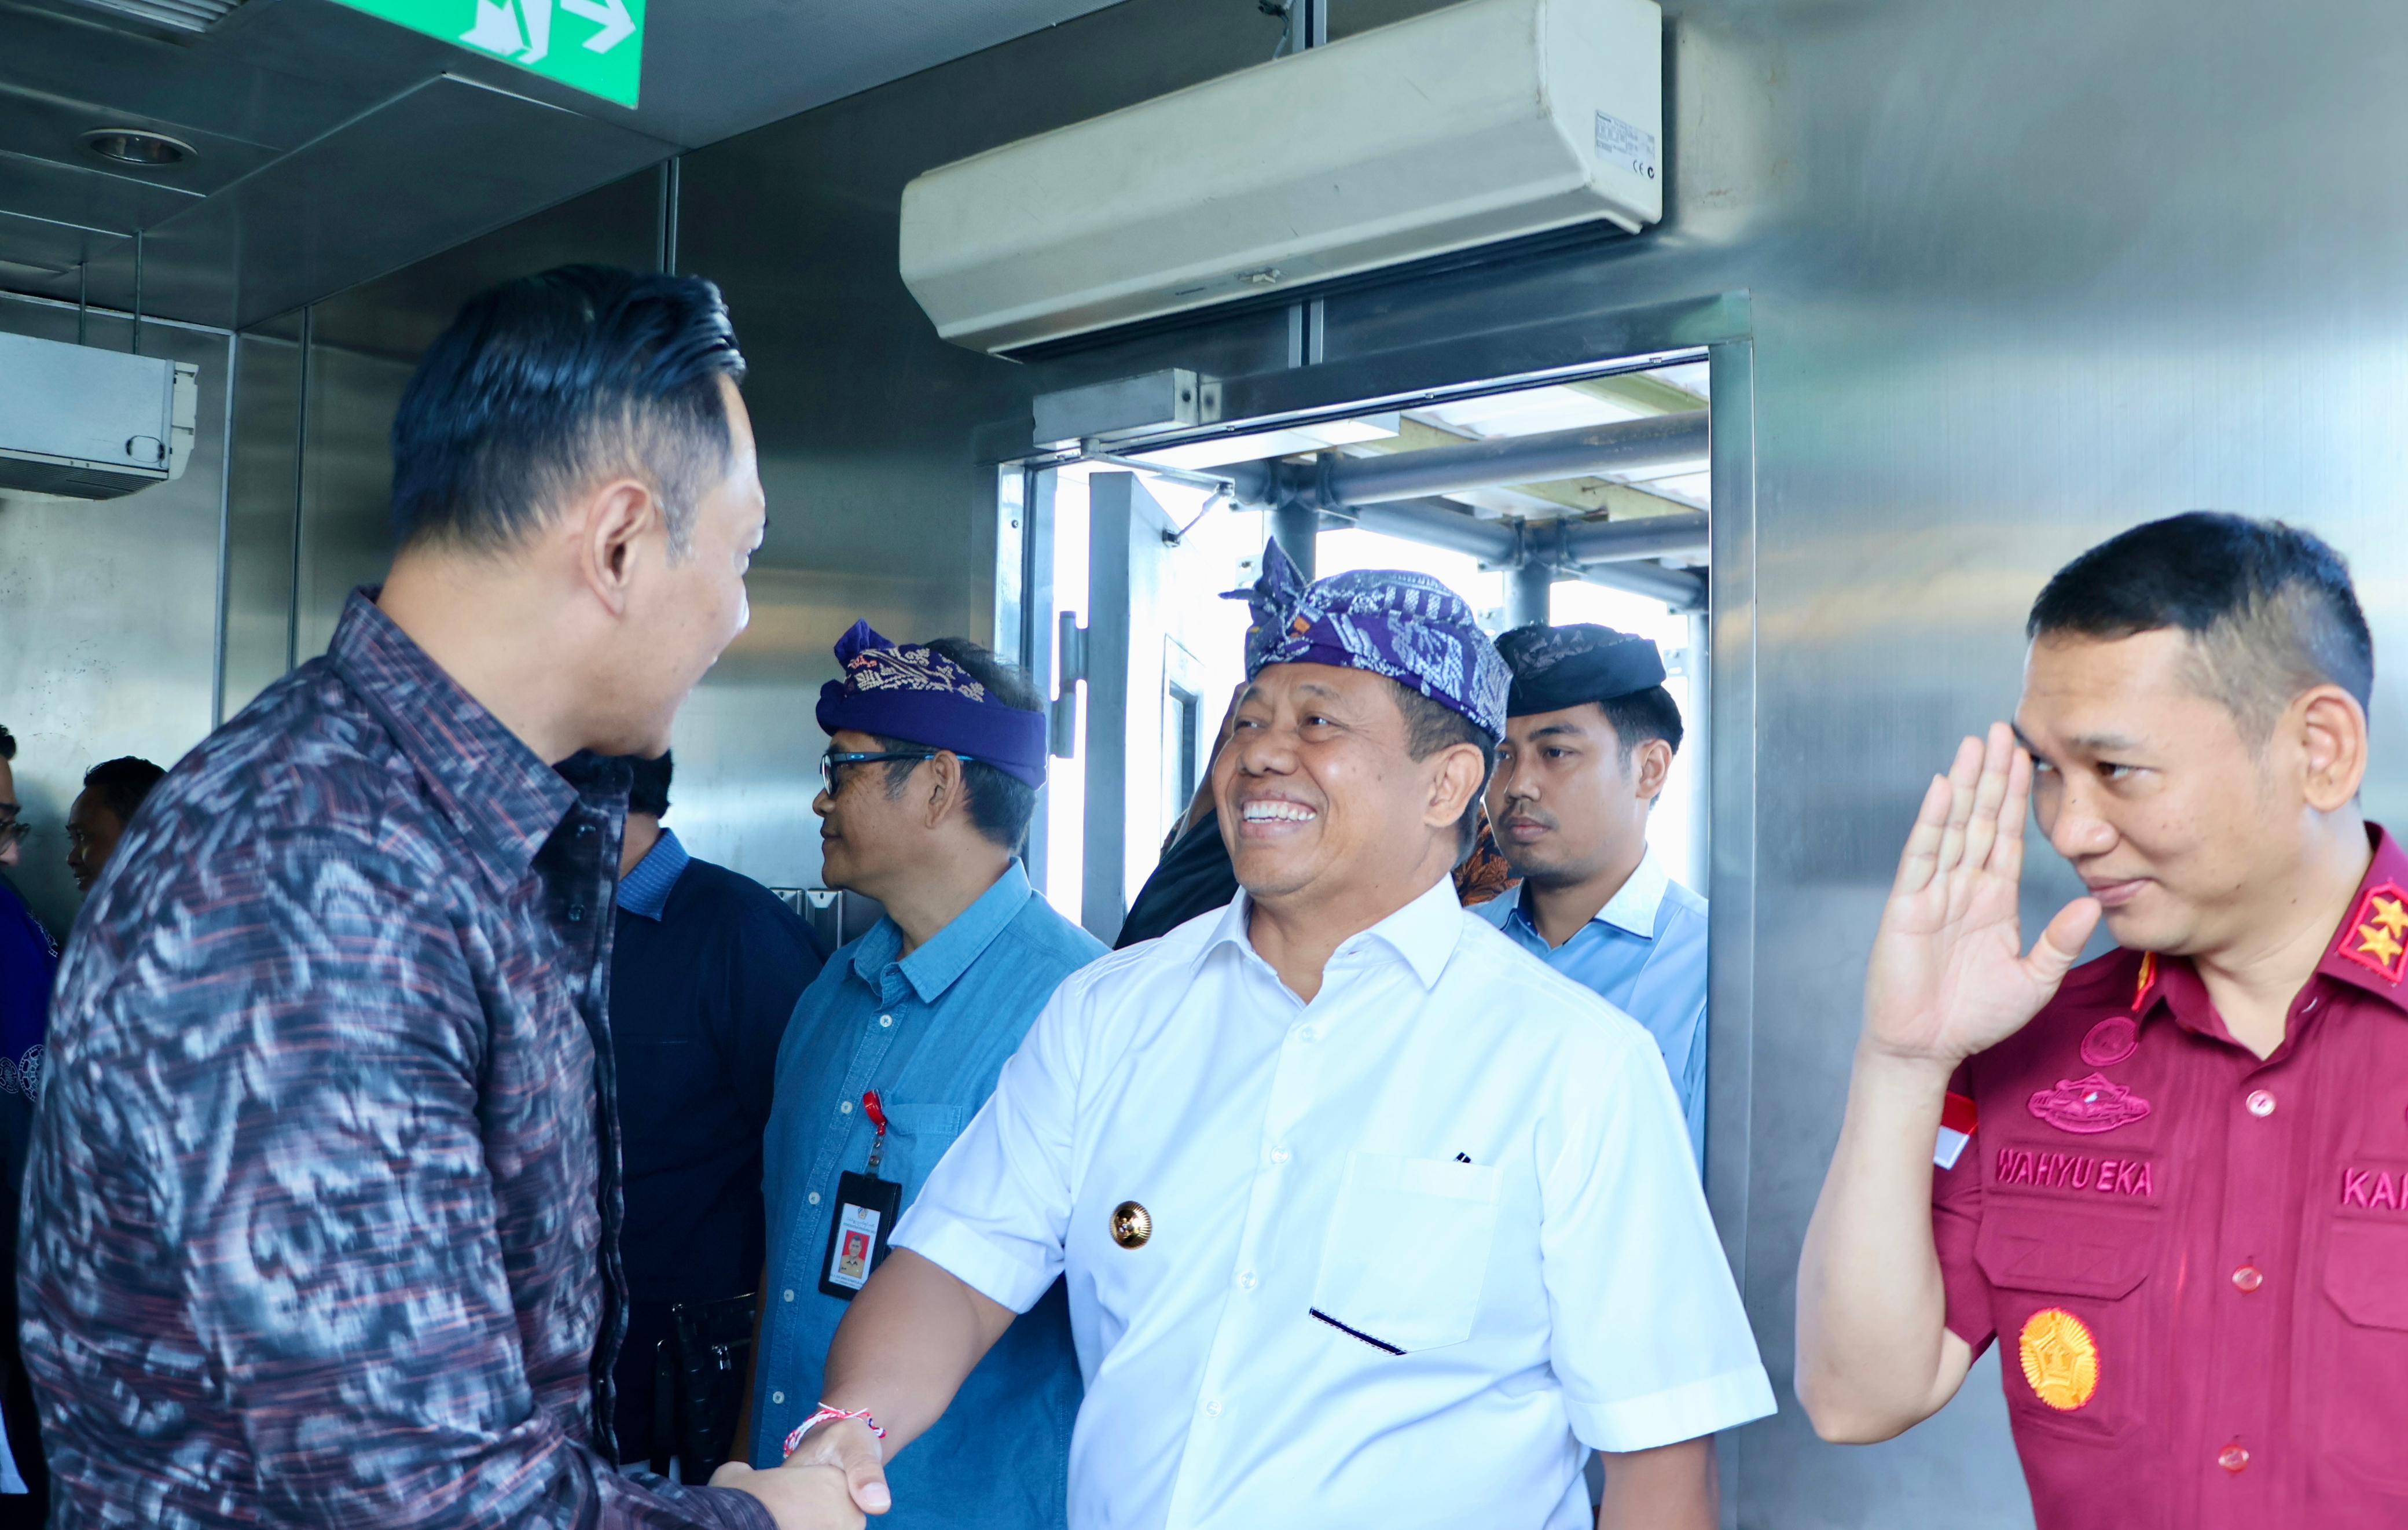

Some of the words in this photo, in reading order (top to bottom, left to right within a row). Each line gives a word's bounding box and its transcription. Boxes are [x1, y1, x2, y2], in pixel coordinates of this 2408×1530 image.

[1998, 1148, 2094, 1189] WAHYU
[2097, 1159, 2153, 1197] EKA
[2343, 1167, 2408, 1210] KA
